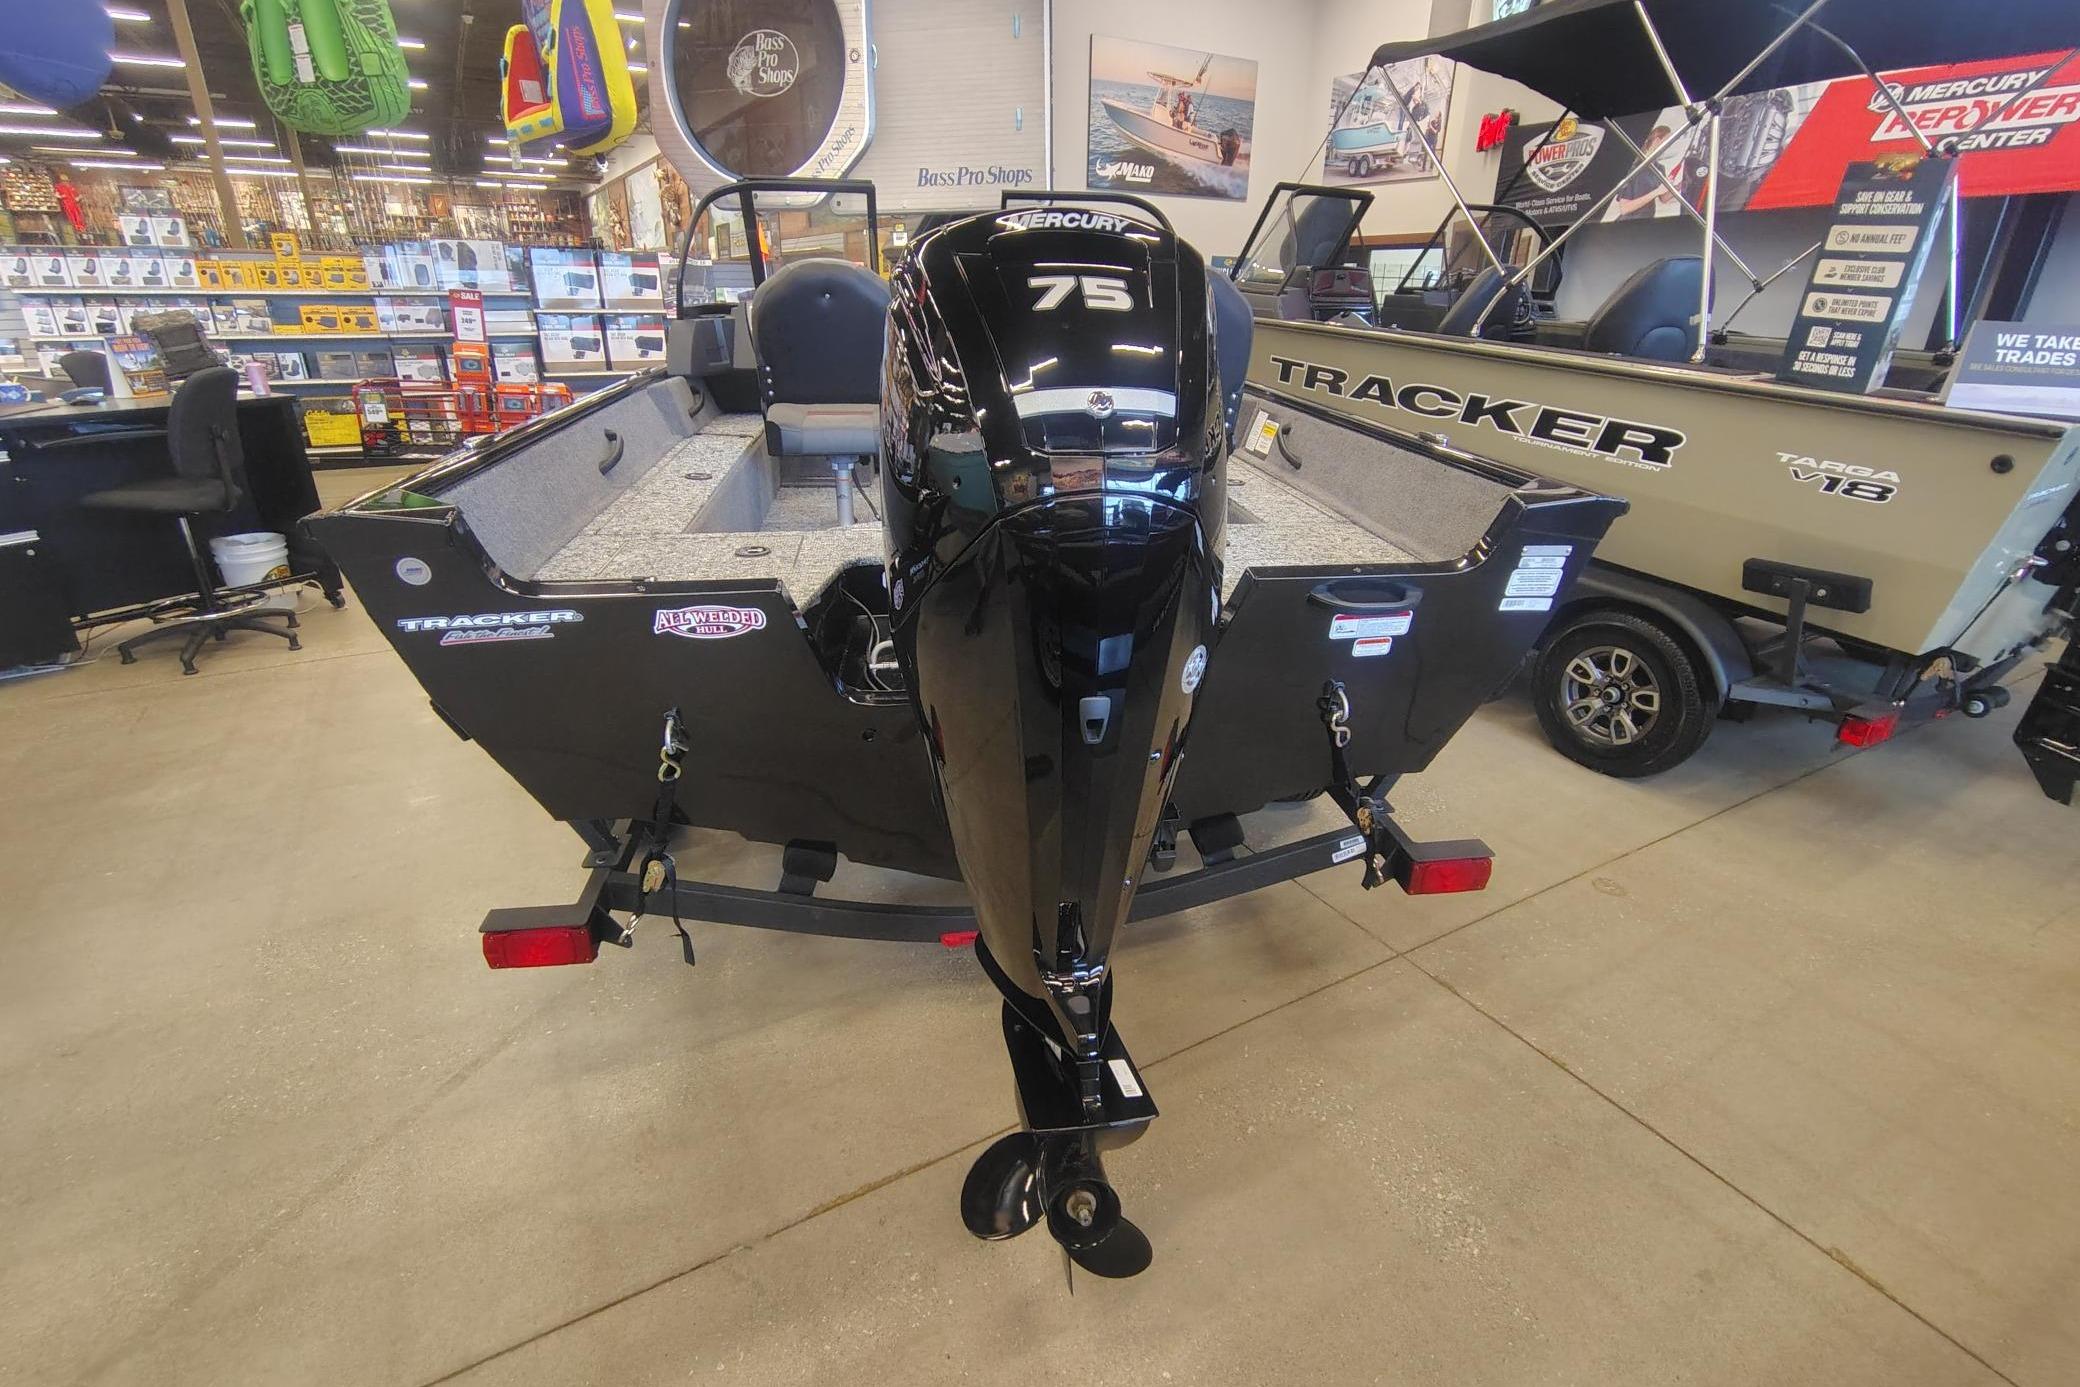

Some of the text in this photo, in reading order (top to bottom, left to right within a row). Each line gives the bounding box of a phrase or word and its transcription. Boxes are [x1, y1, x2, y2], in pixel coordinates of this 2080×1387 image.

[755, 33, 785, 51] Bass
[757, 51, 778, 67] Pro
[758, 67, 794, 87] Shops
[1906, 69, 2050, 102] MERCURY
[1937, 127, 2051, 152] CENTER
[818, 152, 834, 172] Pro
[831, 127, 856, 157] Shops
[917, 165, 1033, 188] Bass Pro Shops
[1116, 162, 1155, 180] MAKO
[1856, 191, 1913, 203] SAVE ON GEAR &
[1840, 203, 1925, 215] SUPPORT CONSERVATION
[1005, 212, 1131, 233] MERCURY
[1850, 233, 1863, 245] NO
[1863, 234, 1889, 245] ANNUAL
[1840, 273, 1862, 282] MEMBER
[1843, 264, 1887, 274] EXCLUSIVE CLUB
[460, 292, 480, 300] SALE
[1027, 275, 1135, 312] 75
[1828, 305, 1877, 318] THAT NEVER EXPIRE
[1831, 298, 1880, 309] UNLIMITED POINTS
[1833, 331, 1847, 340] SCAN
[1997, 333, 2080, 351] WE TAKE
[1798, 350, 1857, 367] GET A RESPONSE IN
[1995, 349, 2077, 367] TRADES
[1792, 361, 1856, 378] 30 SECONDS OR LESS
[1270, 354, 1687, 468] TRACKER
[1512, 435, 1661, 472] TOURNAMENT EDITION
[1776, 451, 1900, 483] TARGA
[1790, 466, 1897, 503] V18
[657, 610, 763, 630] ALL WELDED
[696, 625, 728, 634] HULL
